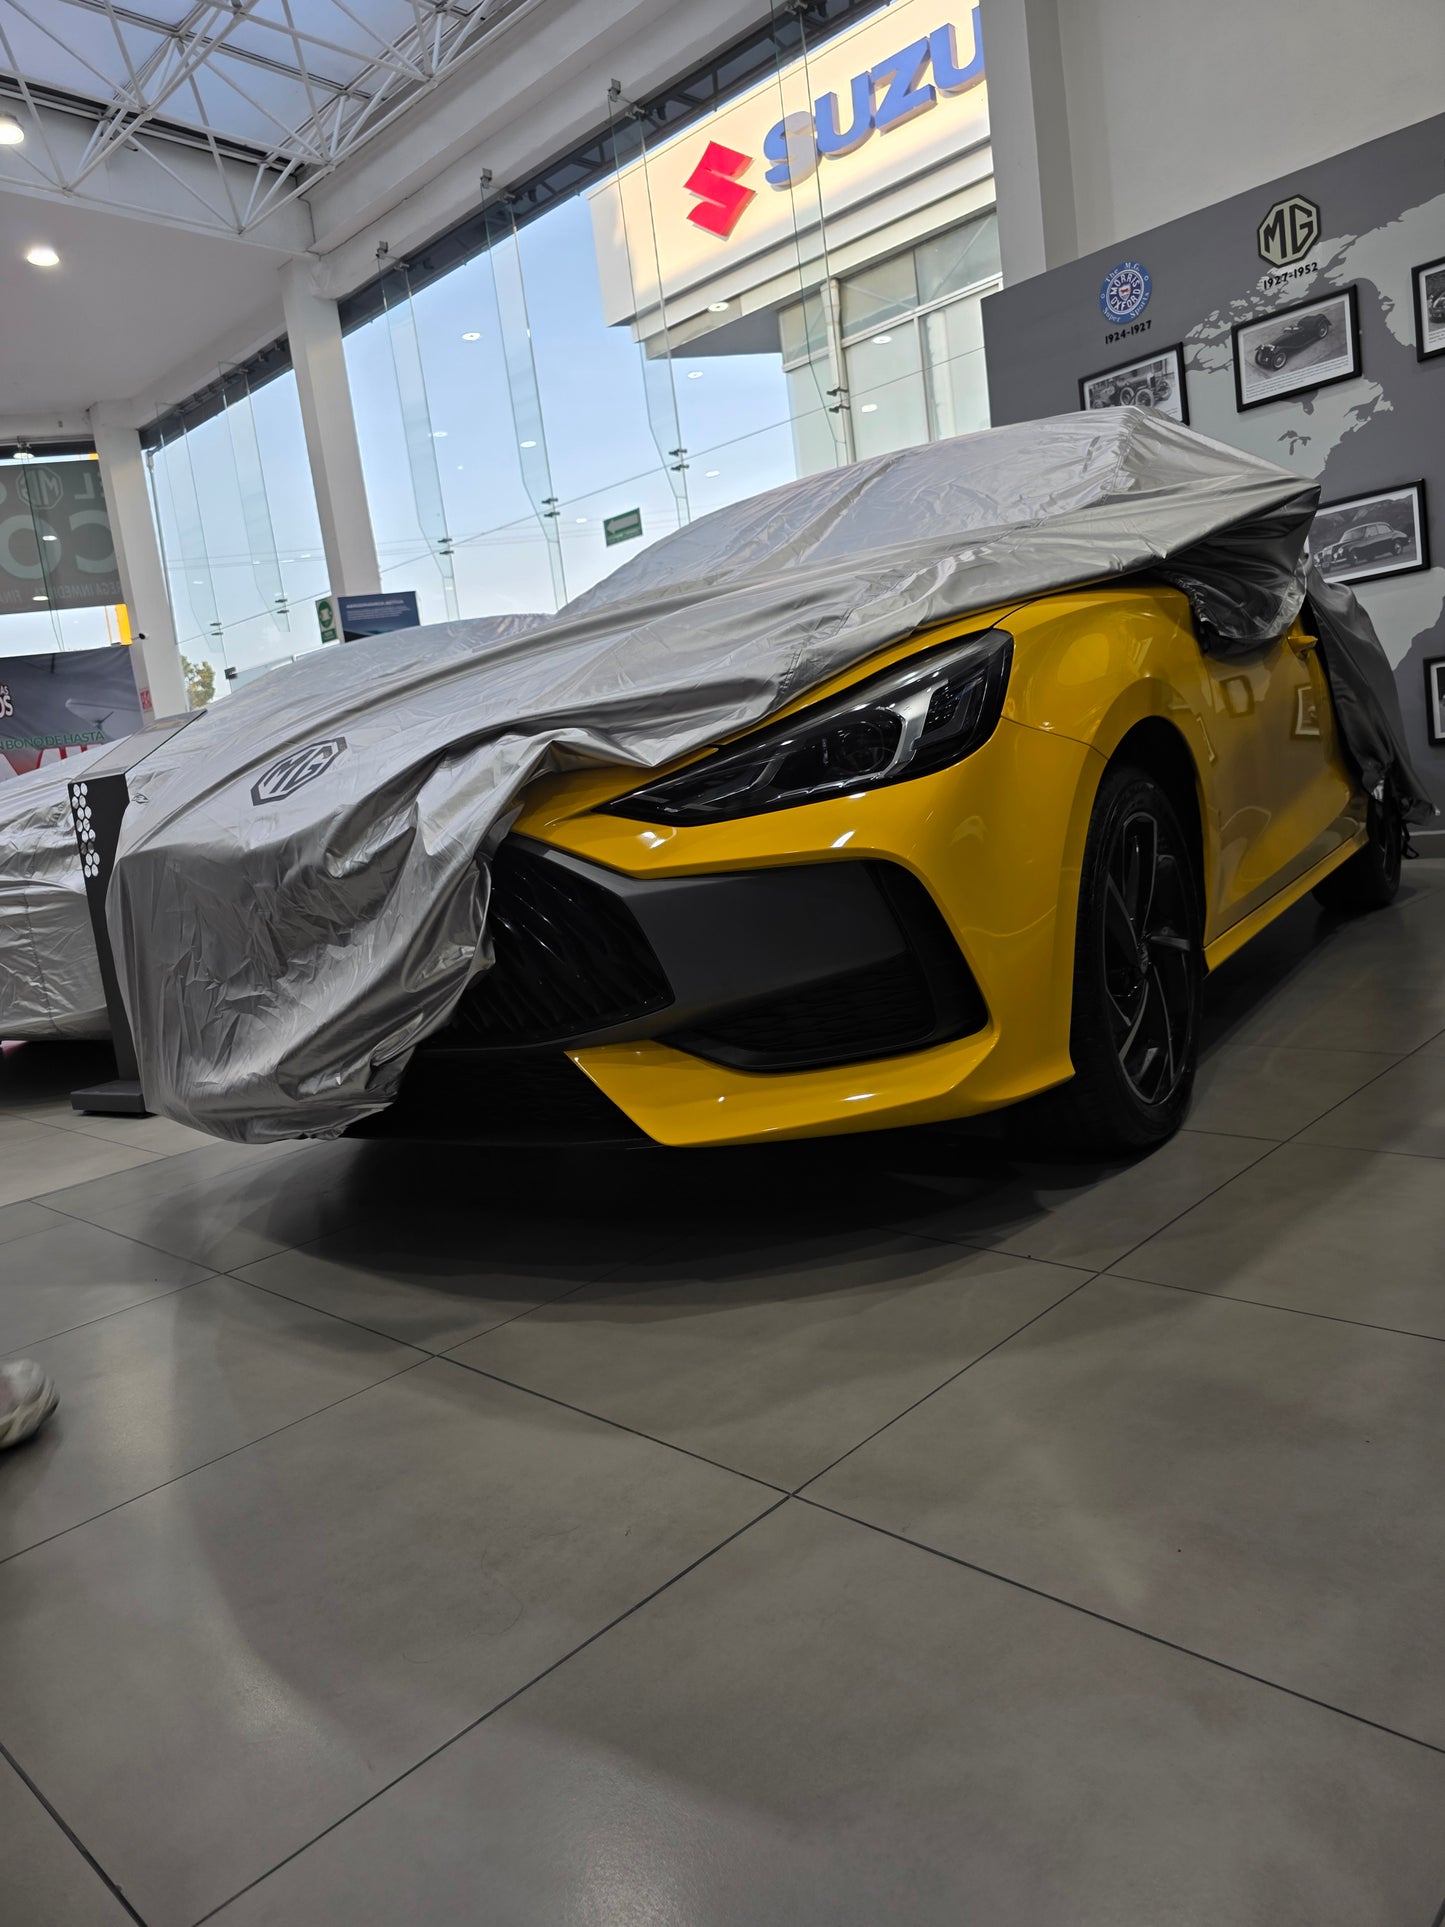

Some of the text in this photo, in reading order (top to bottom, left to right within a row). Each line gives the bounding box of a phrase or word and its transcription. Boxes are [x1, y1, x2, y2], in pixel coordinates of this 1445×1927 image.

[1262, 203, 1314, 260] MG
[1105, 268, 1119, 282] The
[1110, 273, 1140, 295] MORRIS
[1263, 262, 1318, 290] 1927-1952
[1111, 289, 1140, 311] OXFORD
[1105, 320, 1152, 344] 1924-1927
[6, 737, 43, 750] BONO
[43, 735, 61, 746] DE
[64, 731, 105, 744] HASTA
[263, 745, 335, 795] MG
